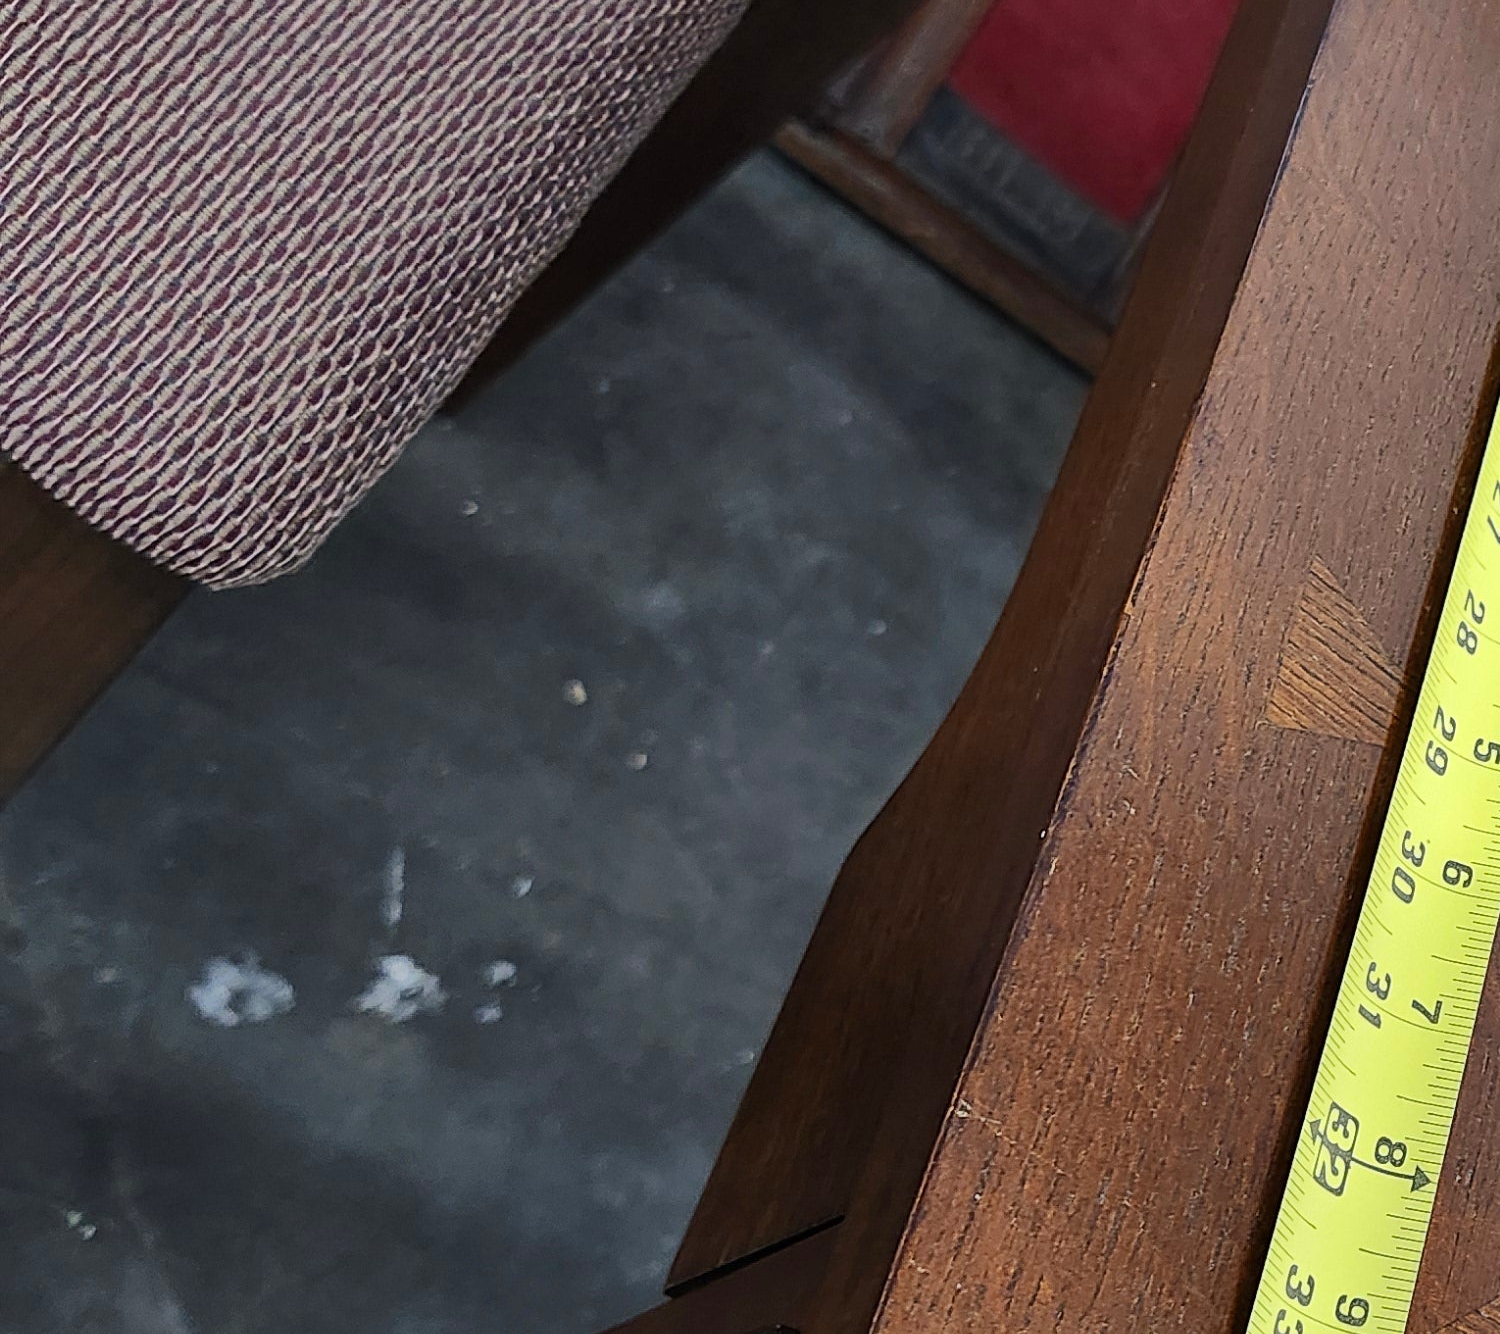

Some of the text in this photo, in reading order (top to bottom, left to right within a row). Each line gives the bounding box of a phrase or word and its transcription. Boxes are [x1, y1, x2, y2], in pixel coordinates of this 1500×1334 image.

[1457, 589, 1486, 656] 28
[1425, 704, 1457, 777] 29
[1391, 829, 1427, 905] 30
[1442, 859, 1474, 889] 6
[1358, 961, 1393, 1030] 31
[1412, 999, 1443, 1025] 7
[1317, 1109, 1357, 1195] 32
[1374, 1135, 1408, 1167] 8
[1335, 1293, 1371, 1328] 9
